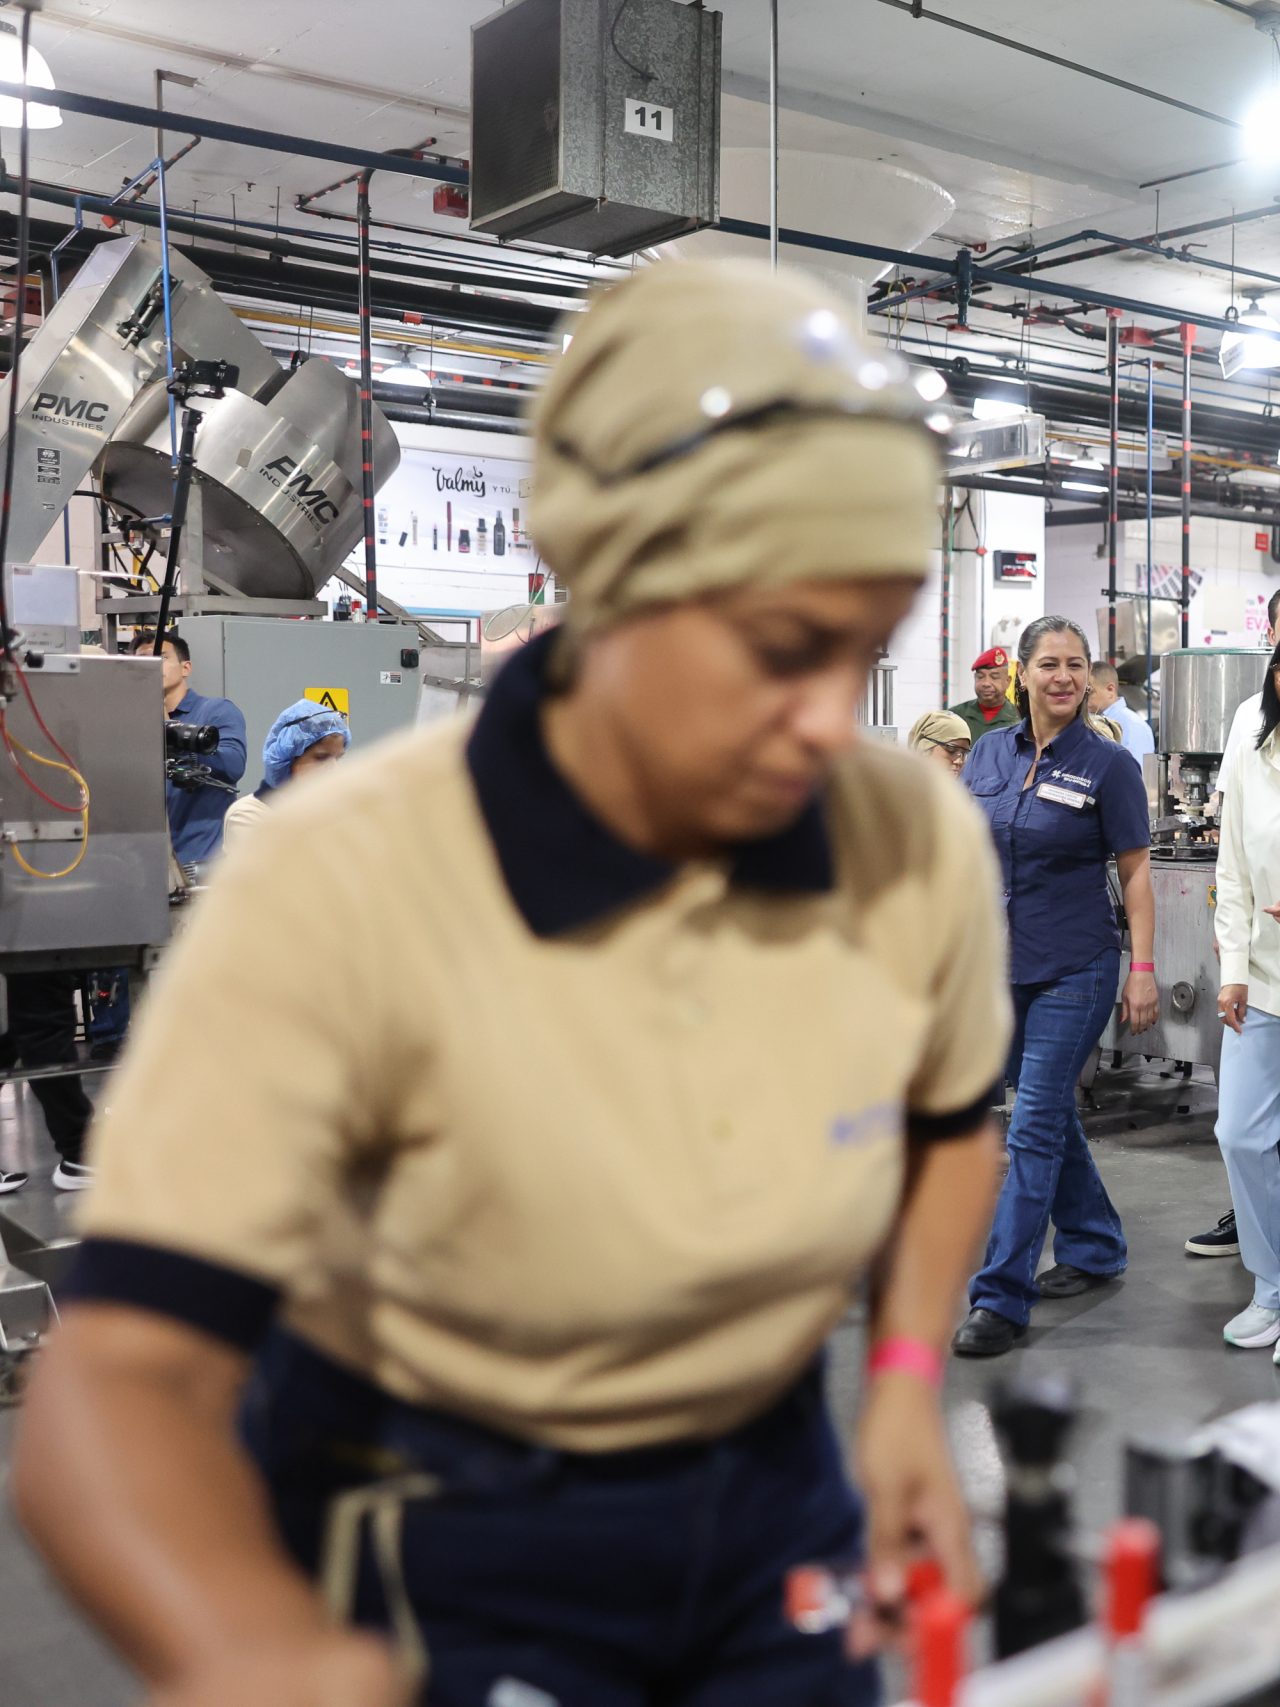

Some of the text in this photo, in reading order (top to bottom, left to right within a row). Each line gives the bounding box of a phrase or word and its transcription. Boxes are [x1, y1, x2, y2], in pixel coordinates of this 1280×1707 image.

[634, 106, 662, 131] 11
[31, 413, 104, 431] INDUSTRIES
[33, 392, 109, 422] PMC
[265, 455, 340, 525] PMC
[432, 465, 486, 498] Valmy
